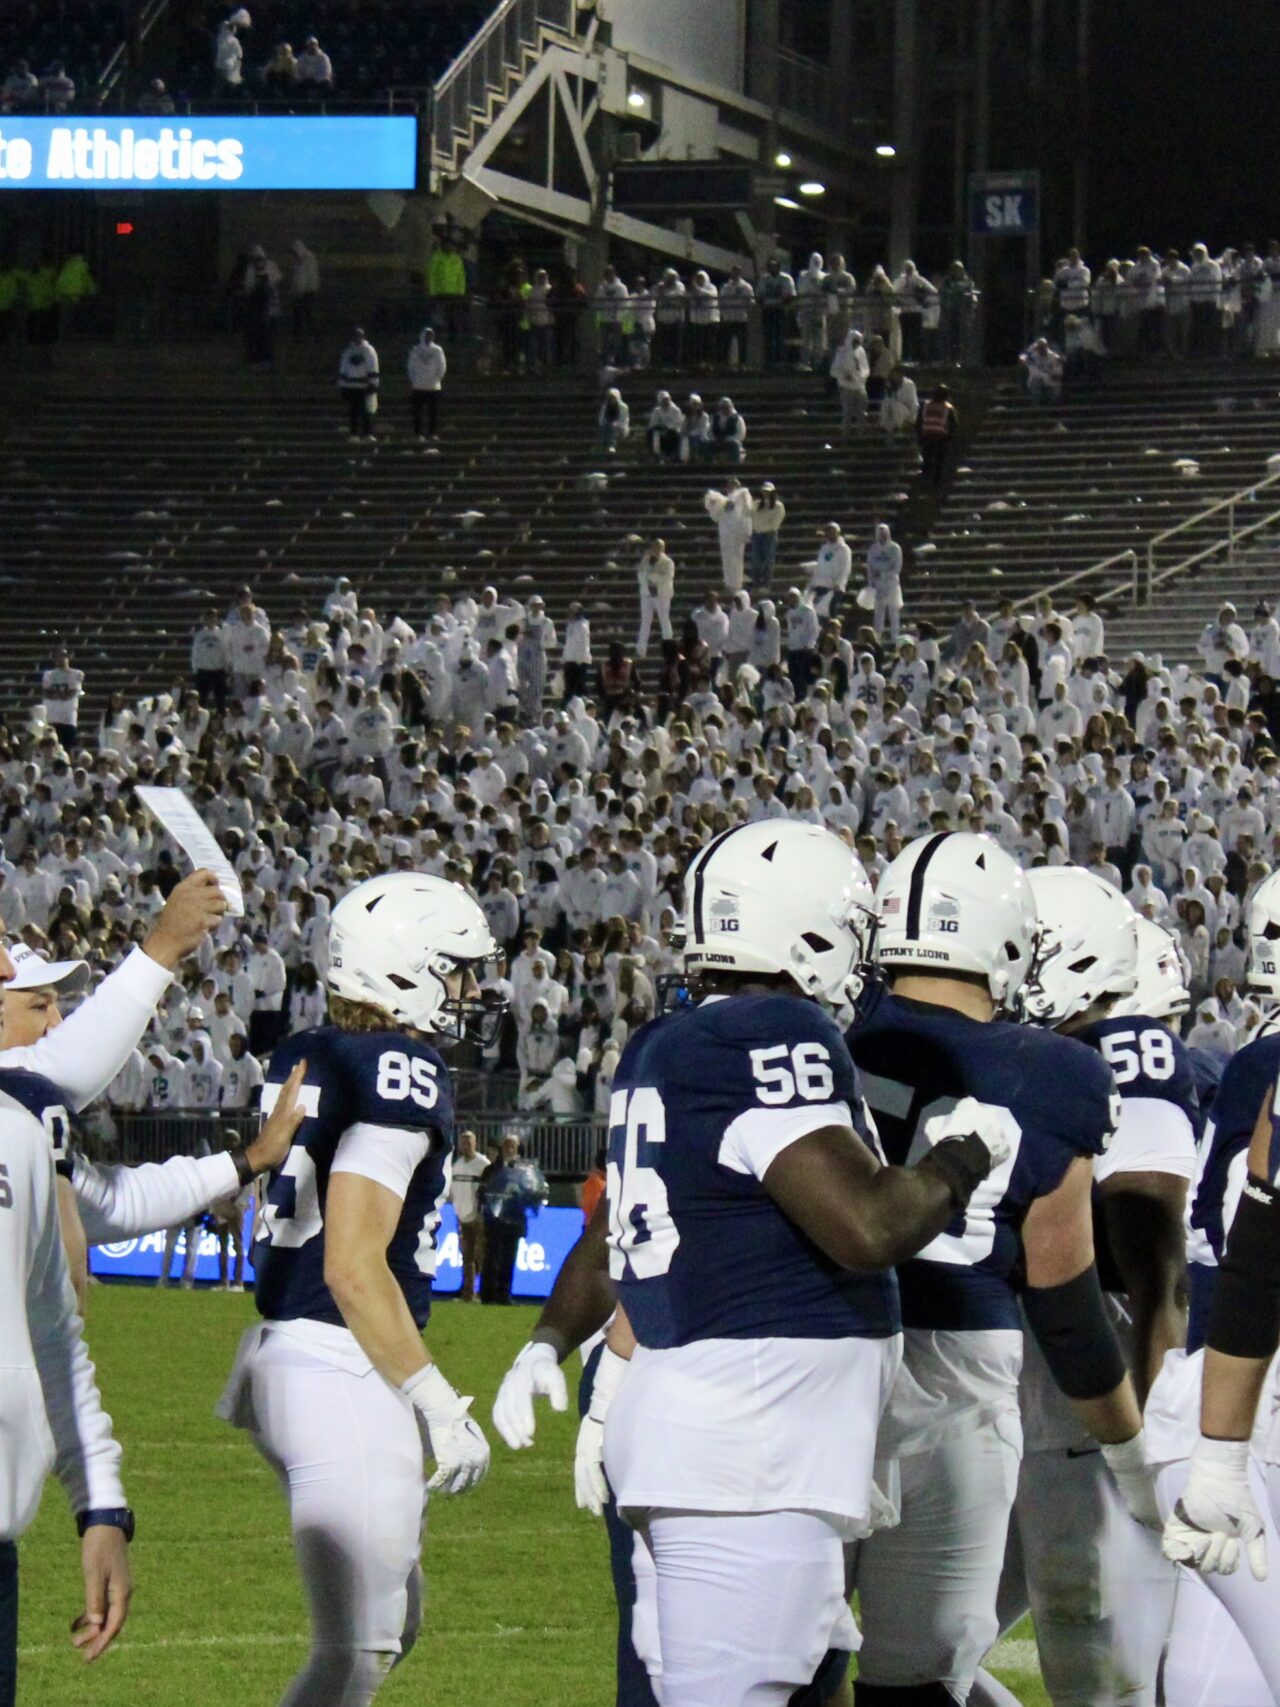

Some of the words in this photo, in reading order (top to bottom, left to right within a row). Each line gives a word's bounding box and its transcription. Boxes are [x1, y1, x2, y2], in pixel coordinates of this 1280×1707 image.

[47, 127, 243, 180] Athletics
[985, 195, 1022, 227] SK
[917, 949, 950, 961] LIONS
[376, 1050, 439, 1109] 85
[749, 1042, 835, 1105] 56
[1100, 1029, 1175, 1084] 58
